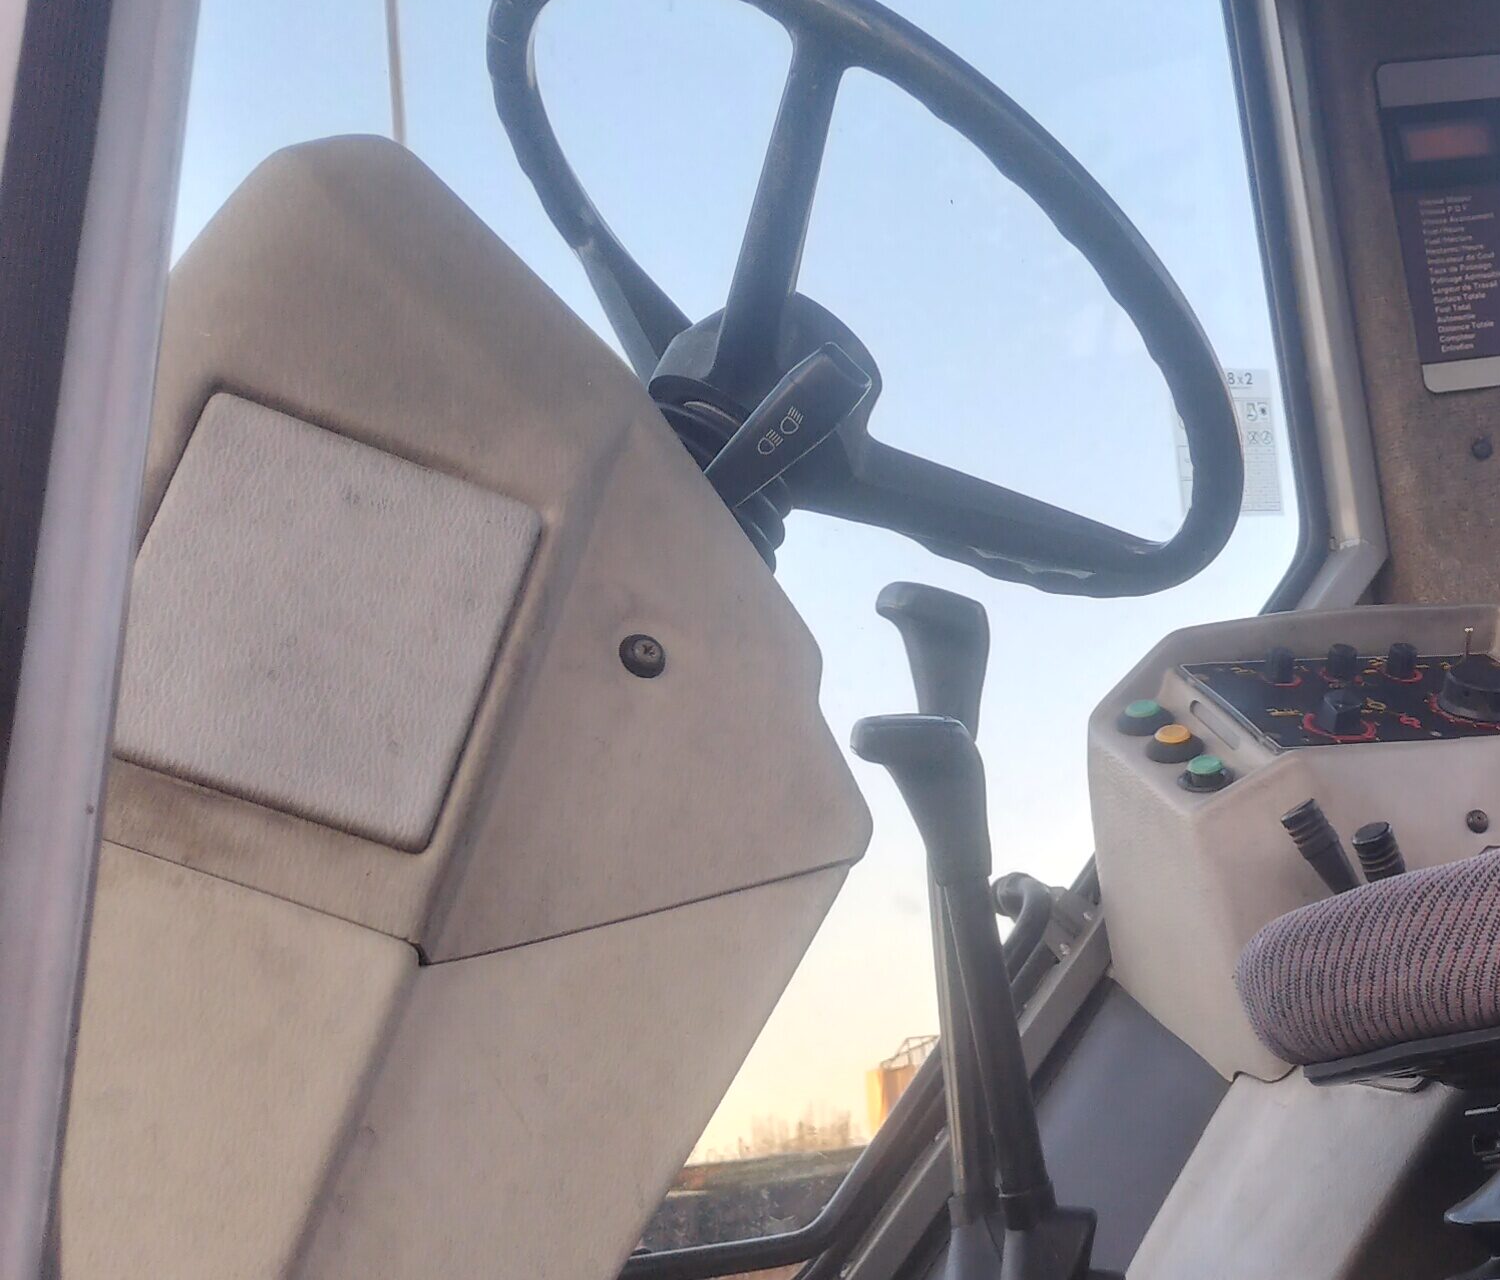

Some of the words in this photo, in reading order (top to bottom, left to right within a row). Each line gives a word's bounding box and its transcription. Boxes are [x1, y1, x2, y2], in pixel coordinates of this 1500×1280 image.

[1473, 280, 1498, 289] Travail
[1462, 292, 1486, 300] Totale
[1452, 303, 1471, 311] Total
[1471, 321, 1495, 329] Totale
